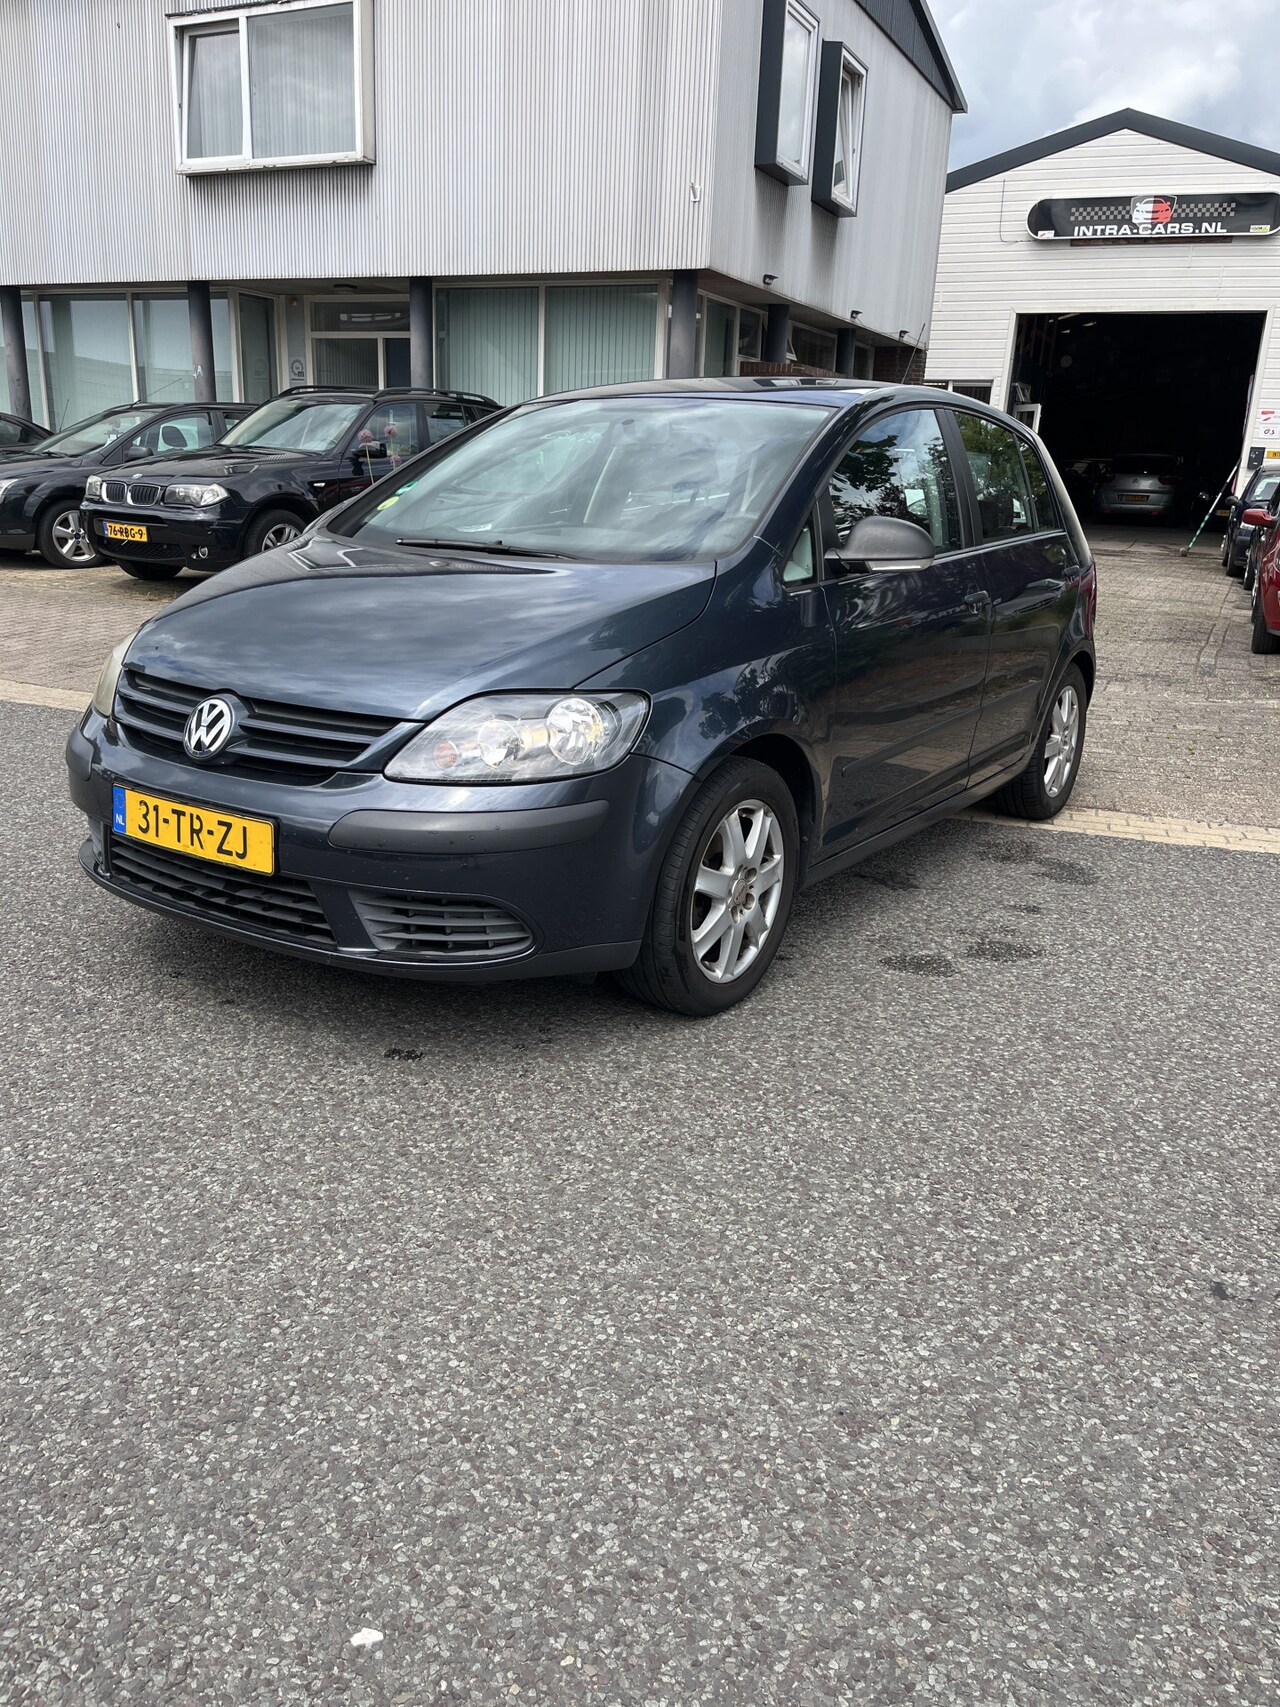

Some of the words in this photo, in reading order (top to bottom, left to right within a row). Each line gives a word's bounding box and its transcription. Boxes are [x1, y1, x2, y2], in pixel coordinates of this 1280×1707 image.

[1073, 221, 1227, 237] INTRA-CARS.NL
[108, 524, 144, 539] 76-RBG-9
[115, 813, 125, 826] NL
[138, 799, 248, 860] 31-TR-ZJ
